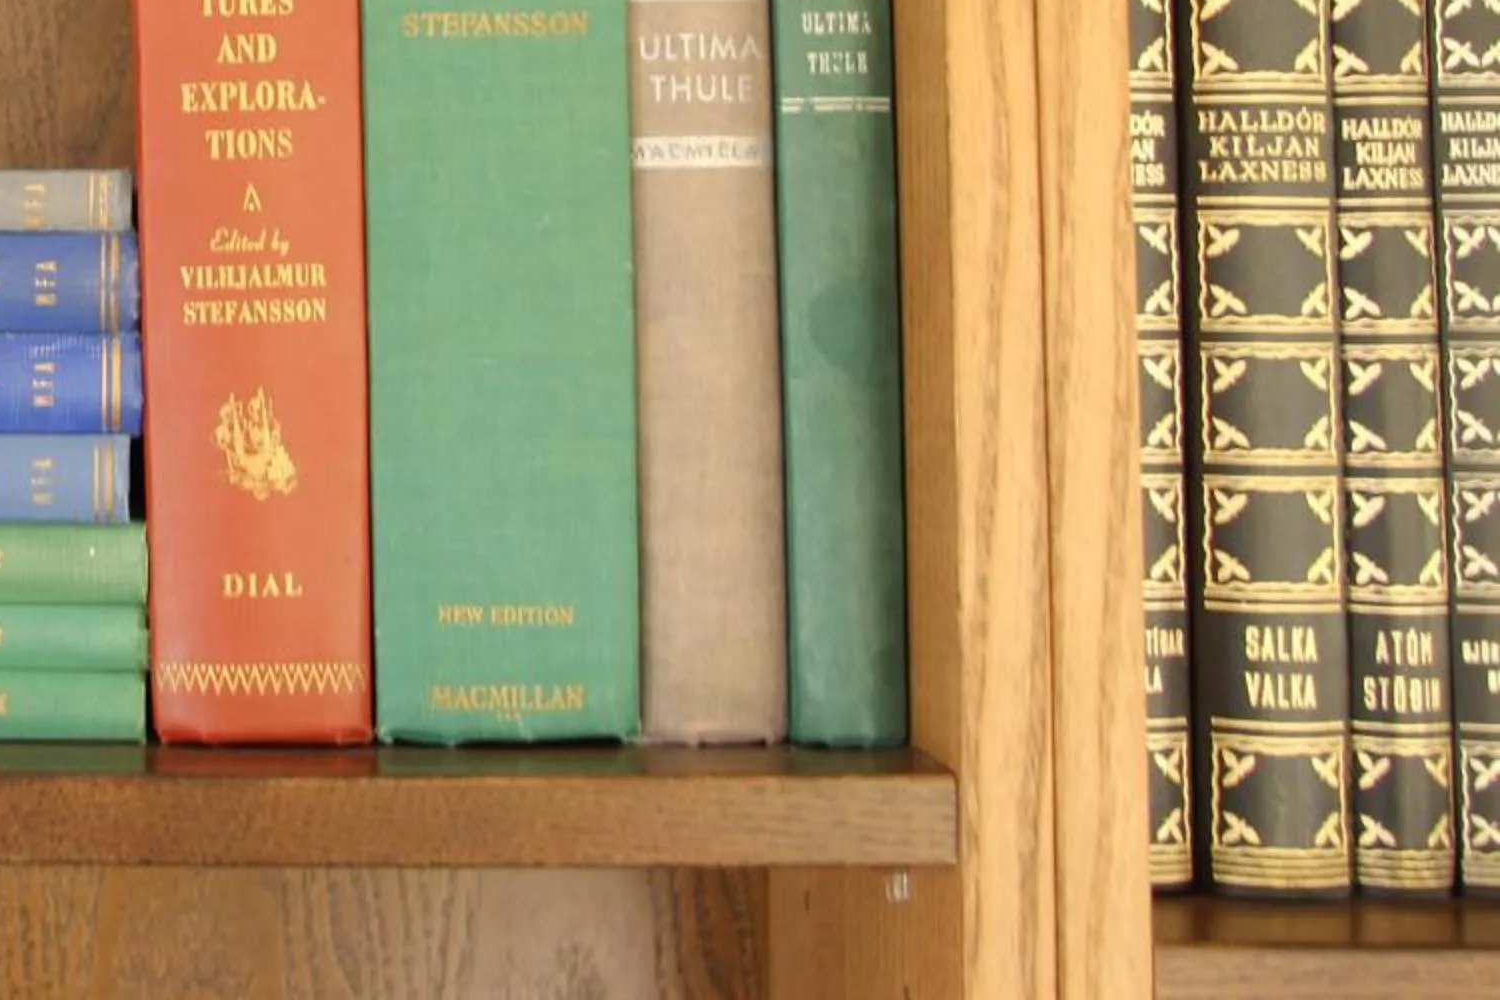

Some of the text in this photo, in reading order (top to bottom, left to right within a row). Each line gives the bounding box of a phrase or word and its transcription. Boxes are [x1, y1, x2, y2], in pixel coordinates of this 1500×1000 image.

[403, 10, 589, 38] STEFANSSON
[802, 11, 871, 35] ULTIMA
[217, 33, 276, 64] AND
[638, 31, 763, 60] ULTIMA
[806, 51, 868, 74] THULE
[180, 80, 326, 112] EXPLORA-
[650, 74, 752, 103] THULE
[1129, 110, 1165, 137] DÓR
[1198, 107, 1326, 134] HALLDÓR
[1441, 111, 1500, 132] HALLD
[206, 127, 292, 160] TIONS
[1130, 138, 1154, 162] AN
[1210, 136, 1320, 157] KILJAN
[1355, 142, 1415, 166] KILJAN
[1198, 159, 1326, 183] LAXNESS
[1344, 167, 1423, 190] LAXNESS
[210, 226, 289, 256] Edited by
[180, 263, 326, 290] VILHJALMUR
[183, 298, 326, 325] STEFANSSON
[223, 572, 302, 599] DIAL
[438, 604, 573, 626] NEW EDITION
[1245, 625, 1317, 663] SALKA
[431, 684, 584, 711] MACMILLAN
[1244, 670, 1317, 710] VALKA
